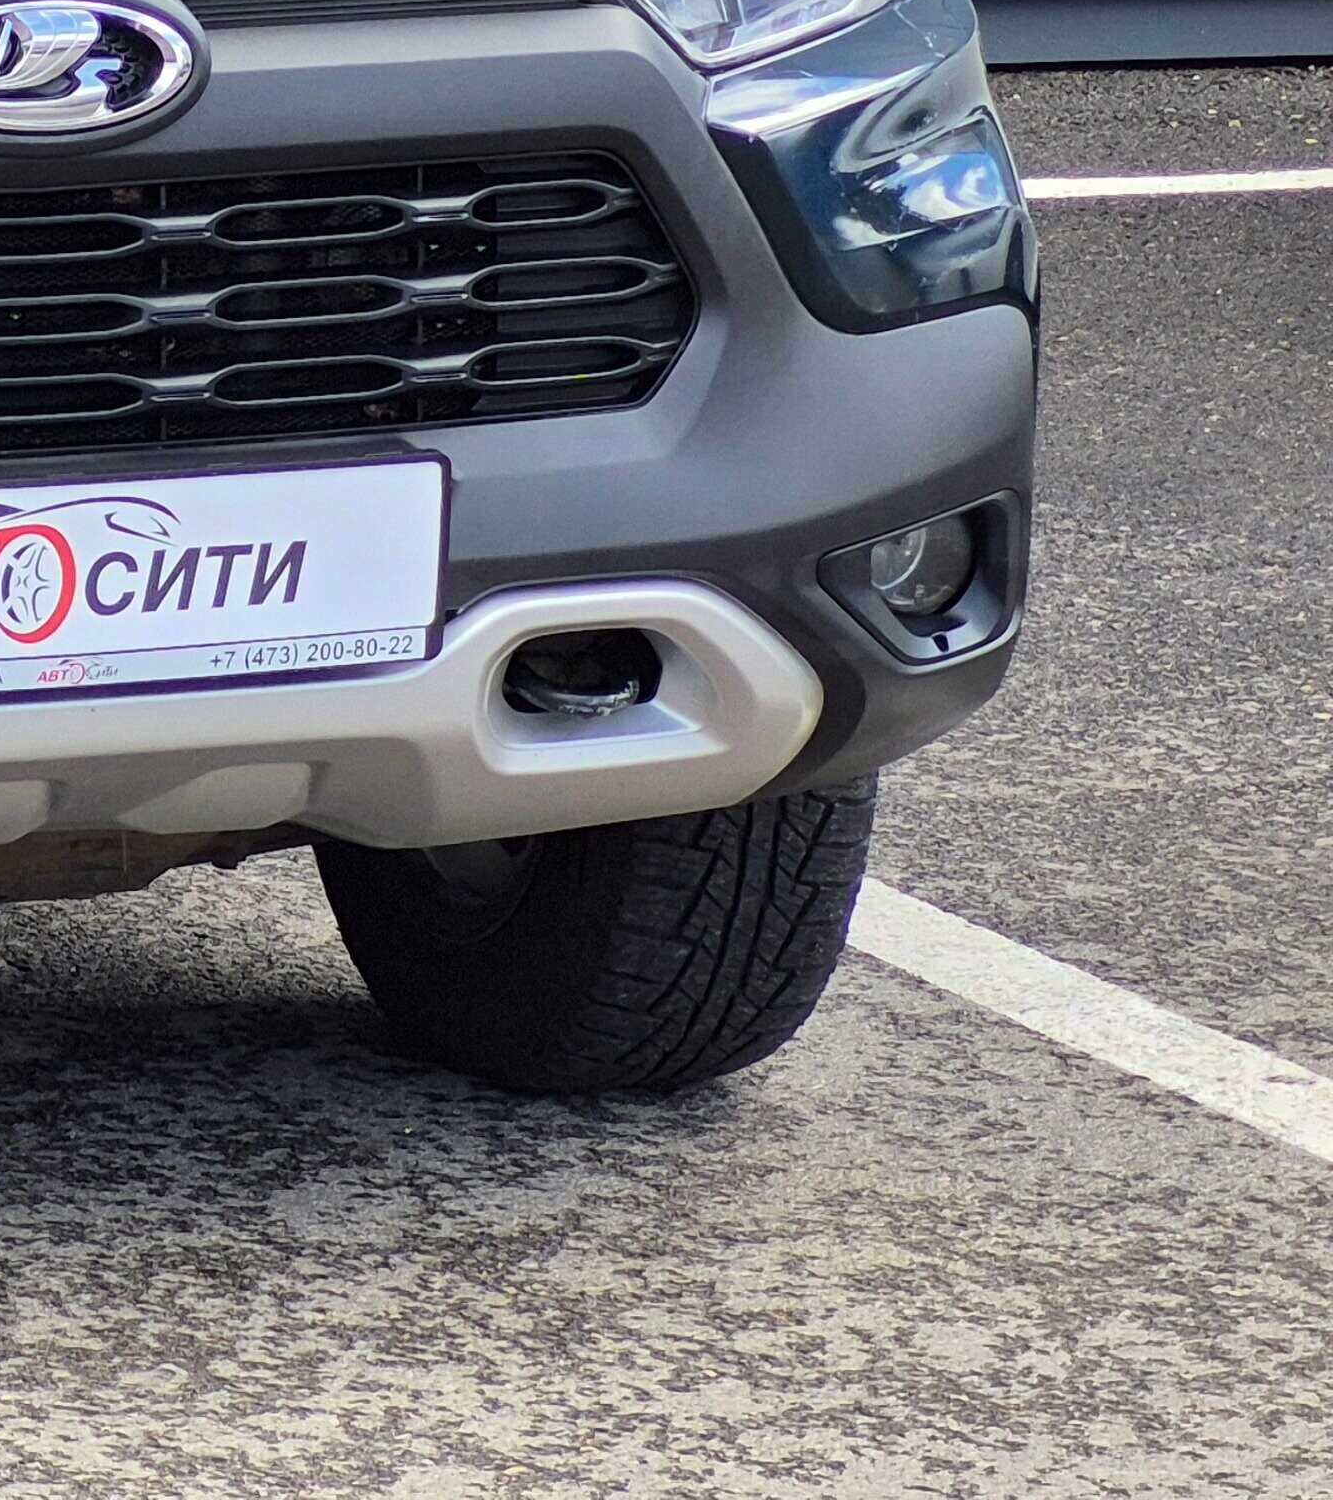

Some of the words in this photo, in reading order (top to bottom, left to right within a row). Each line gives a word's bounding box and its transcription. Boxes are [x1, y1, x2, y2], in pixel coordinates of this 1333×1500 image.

[210, 651, 236, 669] +7
[244, 644, 299, 670] (473)
[307, 635, 413, 661] 200-80-22
